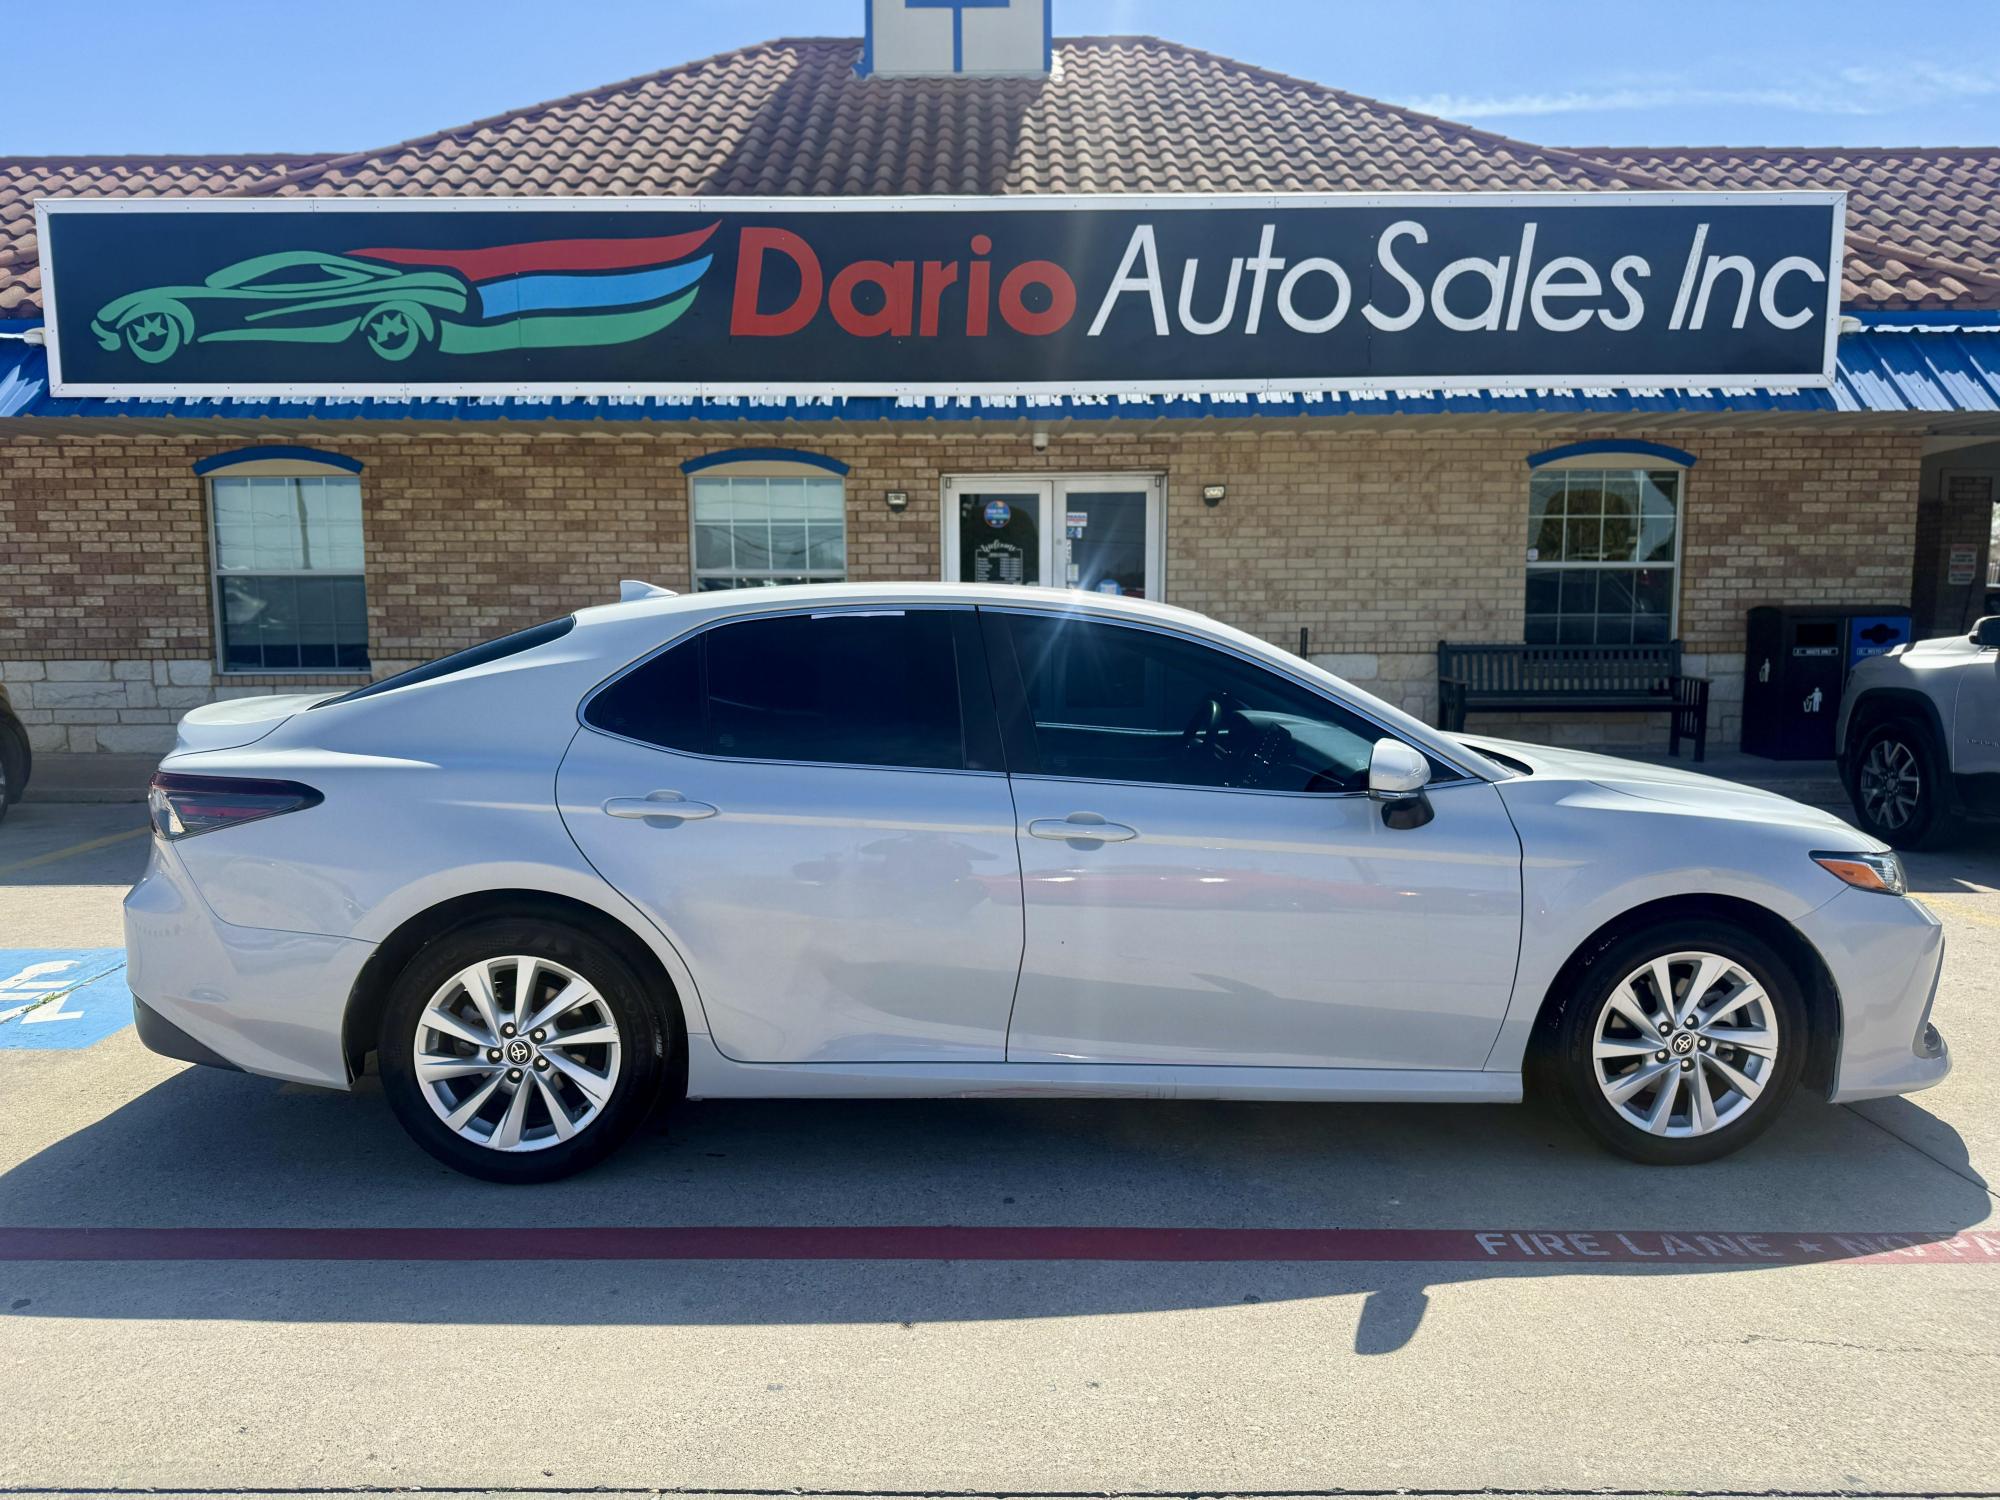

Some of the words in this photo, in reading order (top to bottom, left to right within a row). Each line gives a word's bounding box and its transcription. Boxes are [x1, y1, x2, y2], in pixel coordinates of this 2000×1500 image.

[732, 229, 1074, 336] Dario
[1088, 225, 1351, 335] Auto
[1362, 221, 1650, 331] Sales
[1669, 223, 1825, 331] Inc
[1475, 1233, 1610, 1255] FIRE
[1616, 1233, 1784, 1256] LANE
[1830, 1234, 1926, 1257] NO
